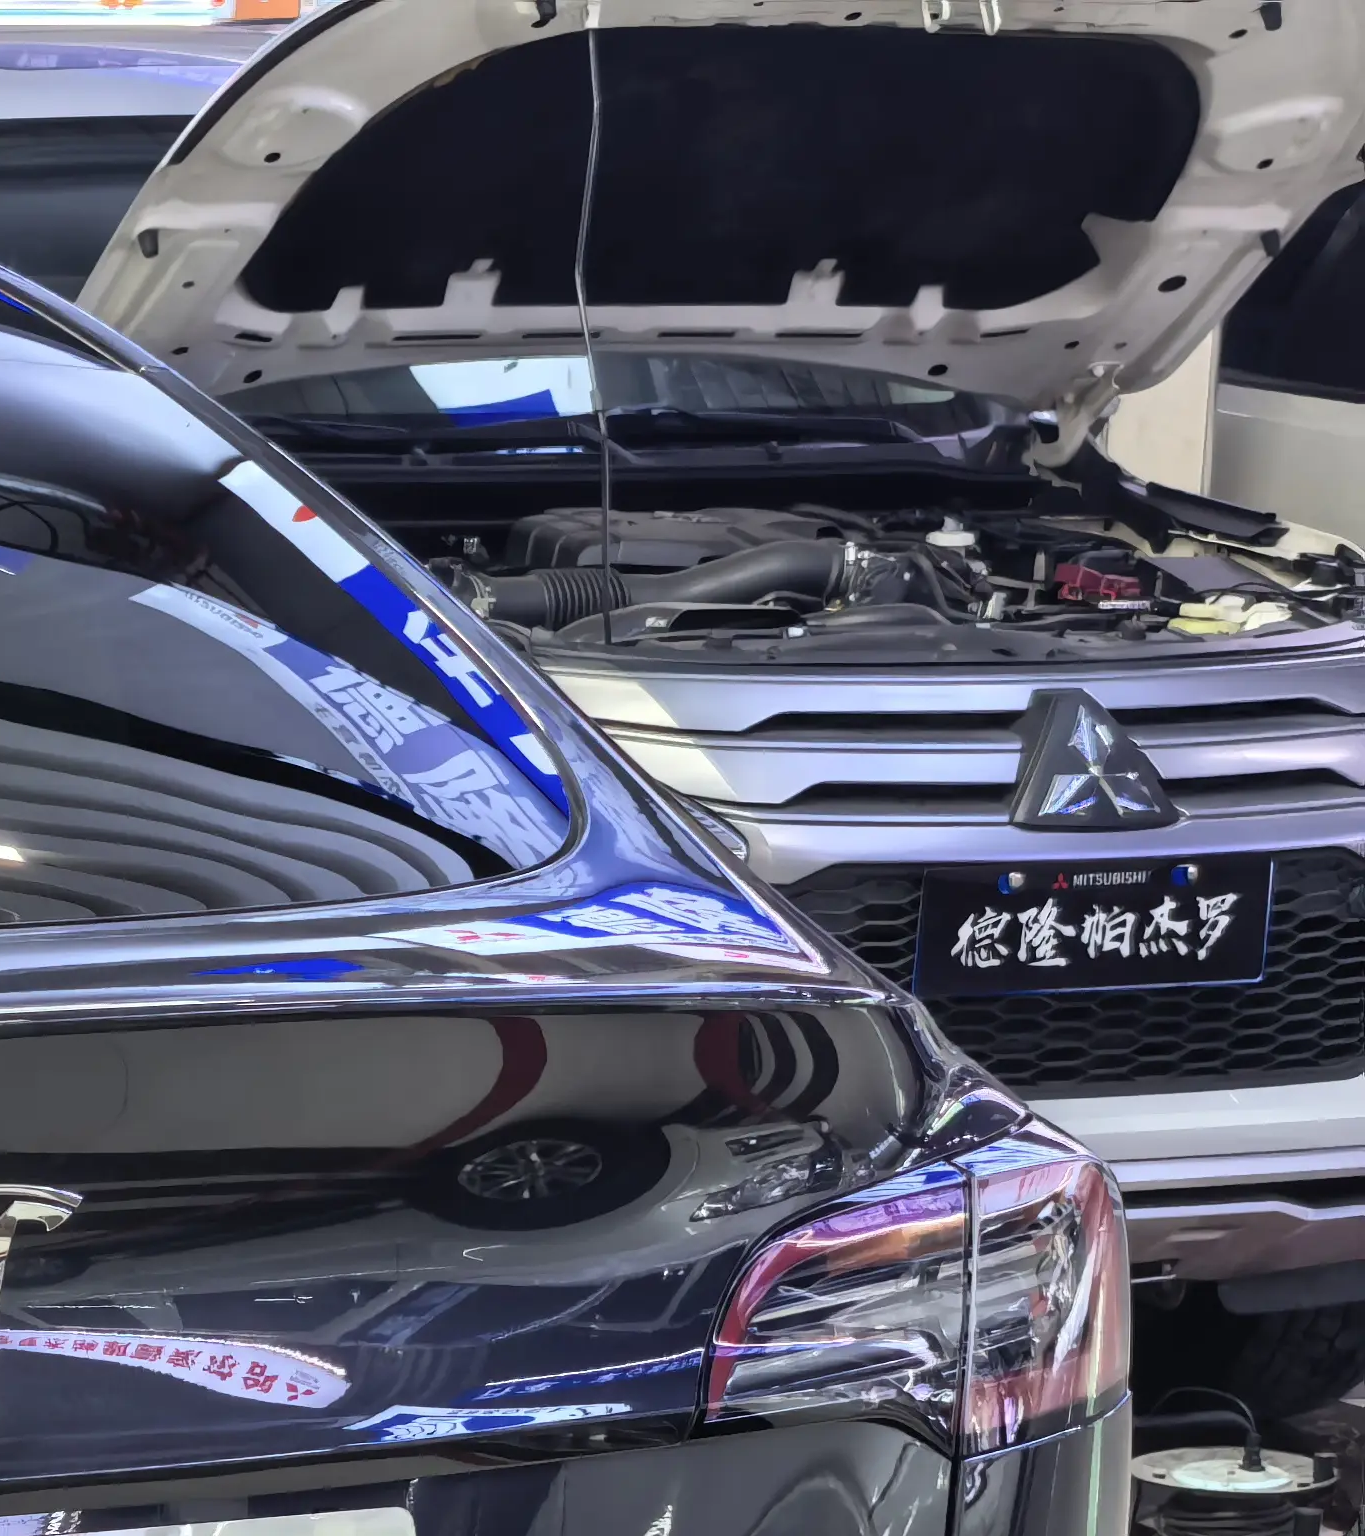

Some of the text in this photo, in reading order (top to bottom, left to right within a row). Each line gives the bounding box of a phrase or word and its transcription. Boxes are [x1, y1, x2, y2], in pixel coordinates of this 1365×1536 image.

[1072, 870, 1152, 889] MITSUBISHI
[950, 892, 1241, 968] 德隆帕杰罗
